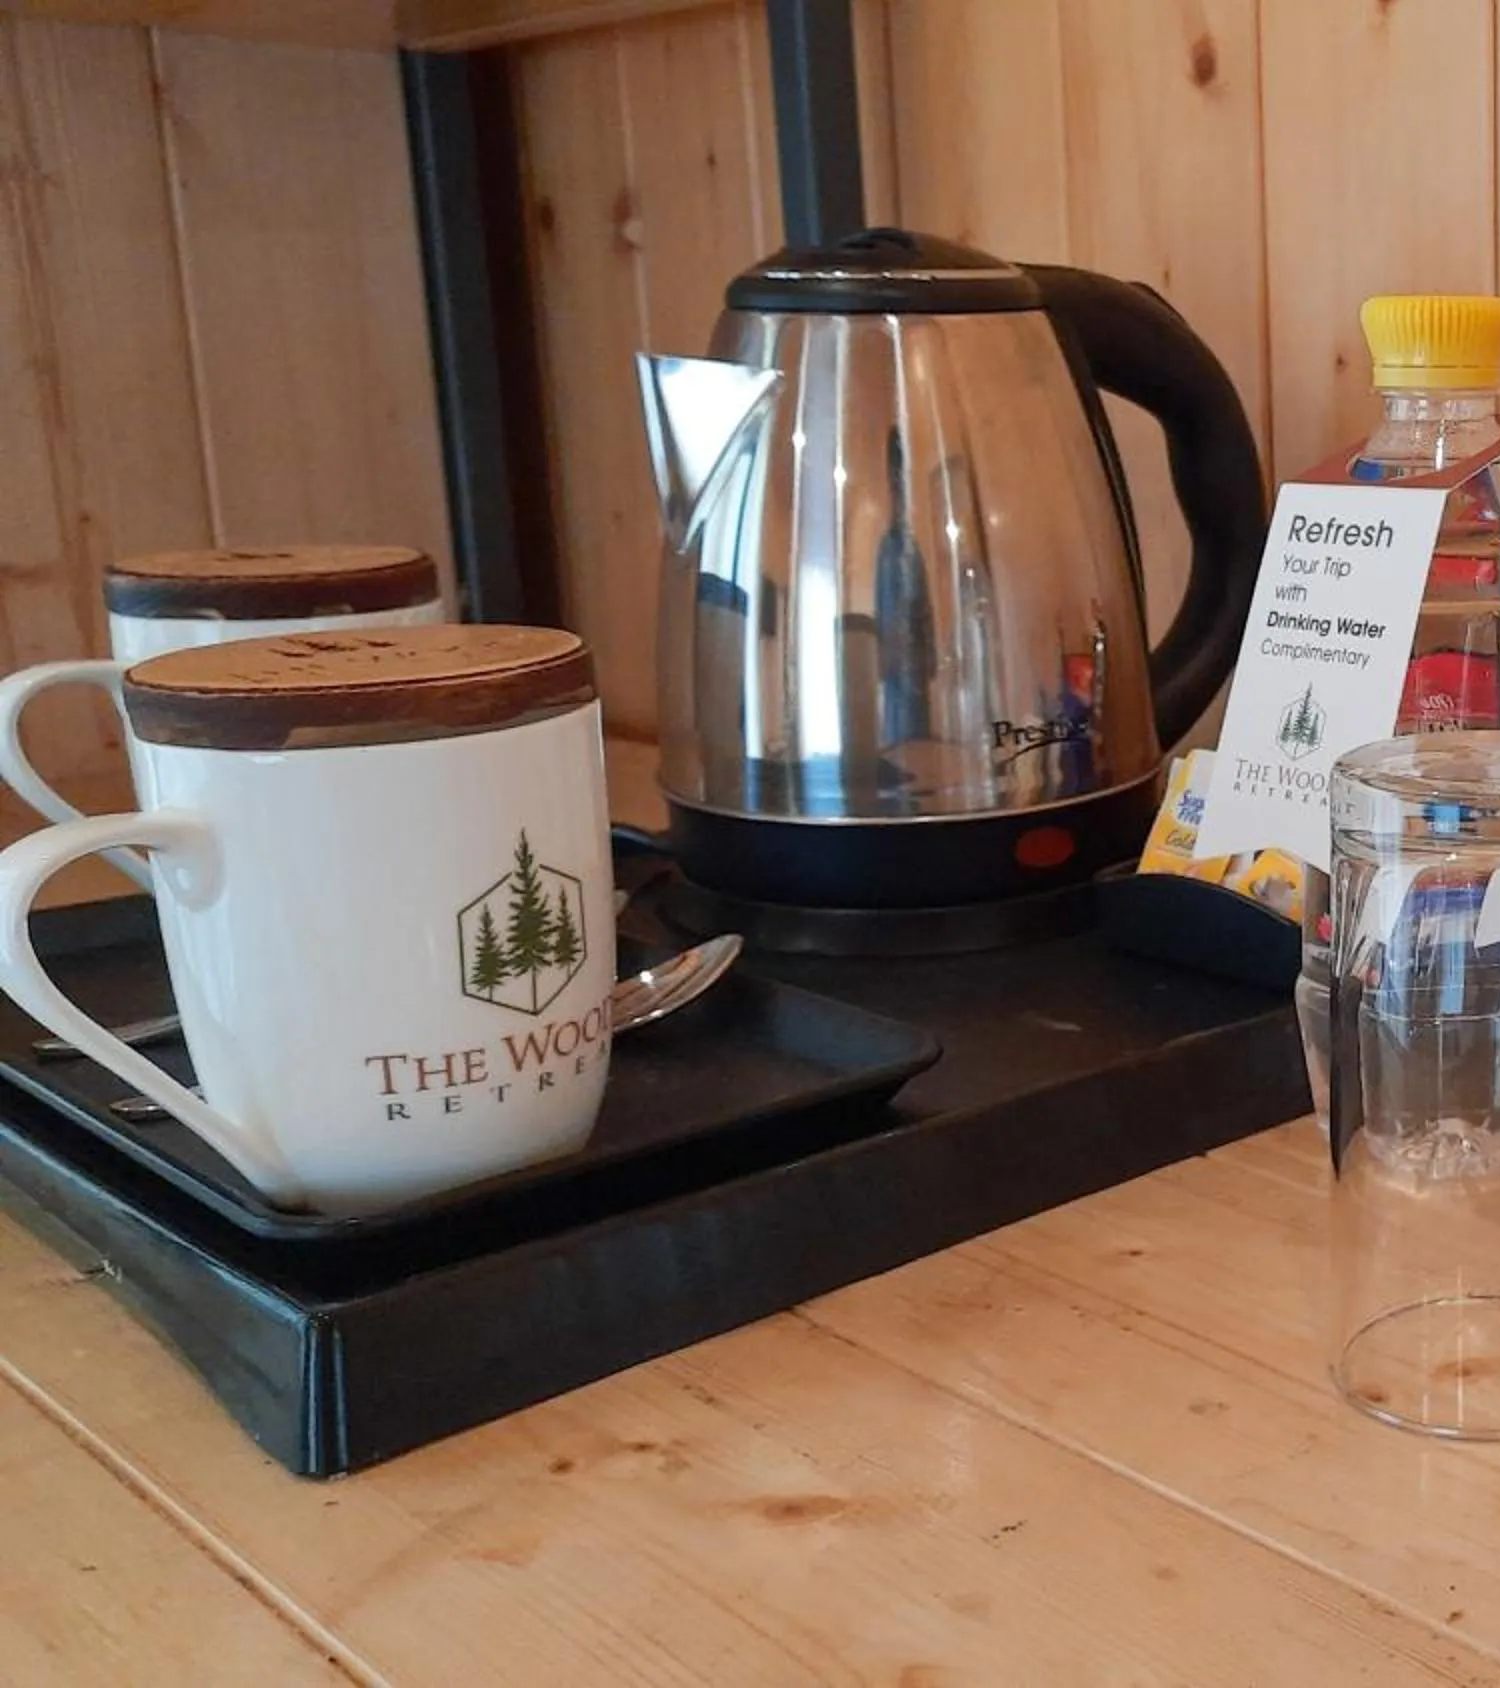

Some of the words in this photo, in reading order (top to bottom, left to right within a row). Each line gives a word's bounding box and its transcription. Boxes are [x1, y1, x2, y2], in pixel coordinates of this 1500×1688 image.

[1288, 515, 1394, 548] Refresh
[1283, 553, 1320, 575] Your
[1323, 556, 1352, 581] Trip
[1275, 584, 1307, 602] with
[1267, 611, 1332, 637] Drinking
[1337, 616, 1386, 639] Water
[1260, 638, 1371, 670] Complimentary
[1236, 759, 1271, 782] THE
[1279, 766, 1329, 793] WOO
[365, 1048, 489, 1095] THE
[502, 998, 609, 1072] WOO
